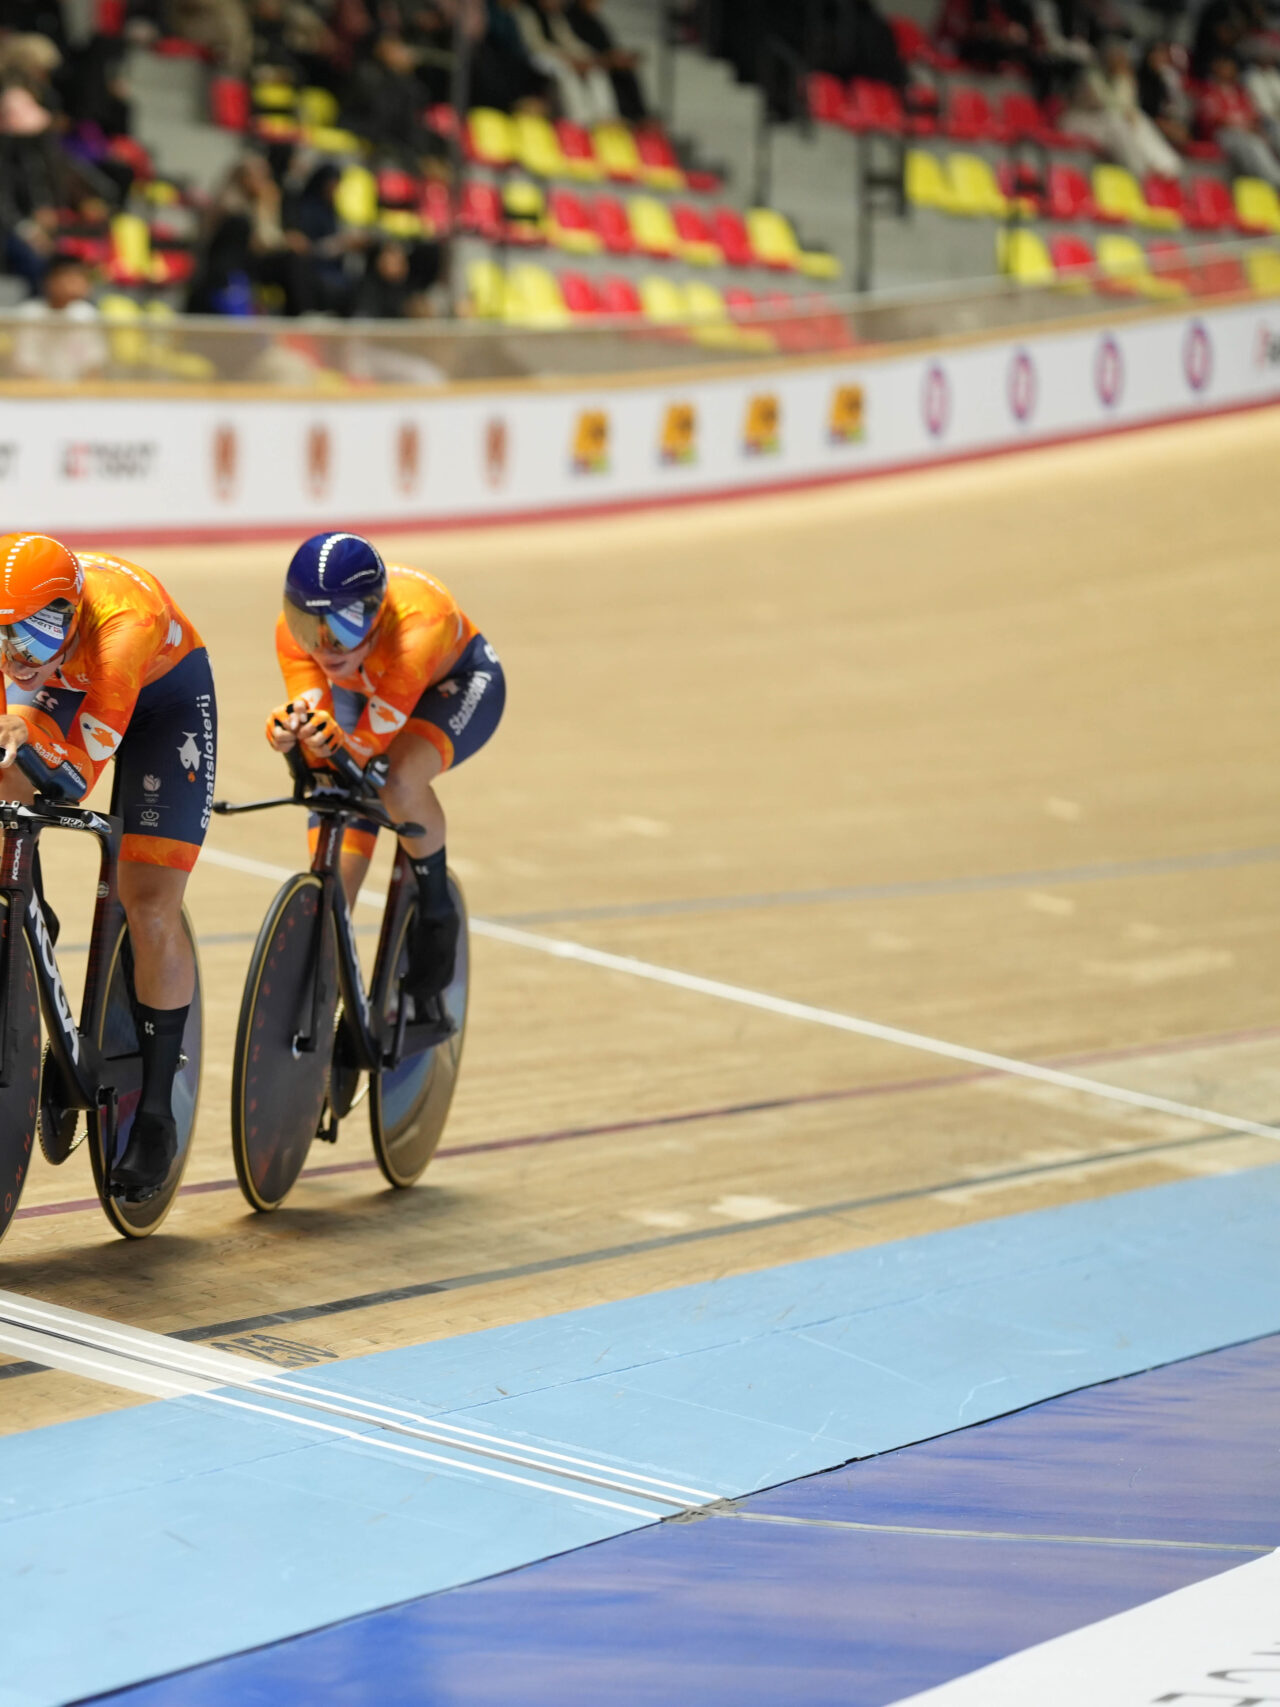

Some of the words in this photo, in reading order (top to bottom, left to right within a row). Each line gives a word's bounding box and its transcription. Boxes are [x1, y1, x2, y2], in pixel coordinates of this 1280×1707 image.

[196, 693, 215, 832] Staatsloterij
[12, 838, 24, 881] KOGA
[28, 886, 80, 1067] KOGA
